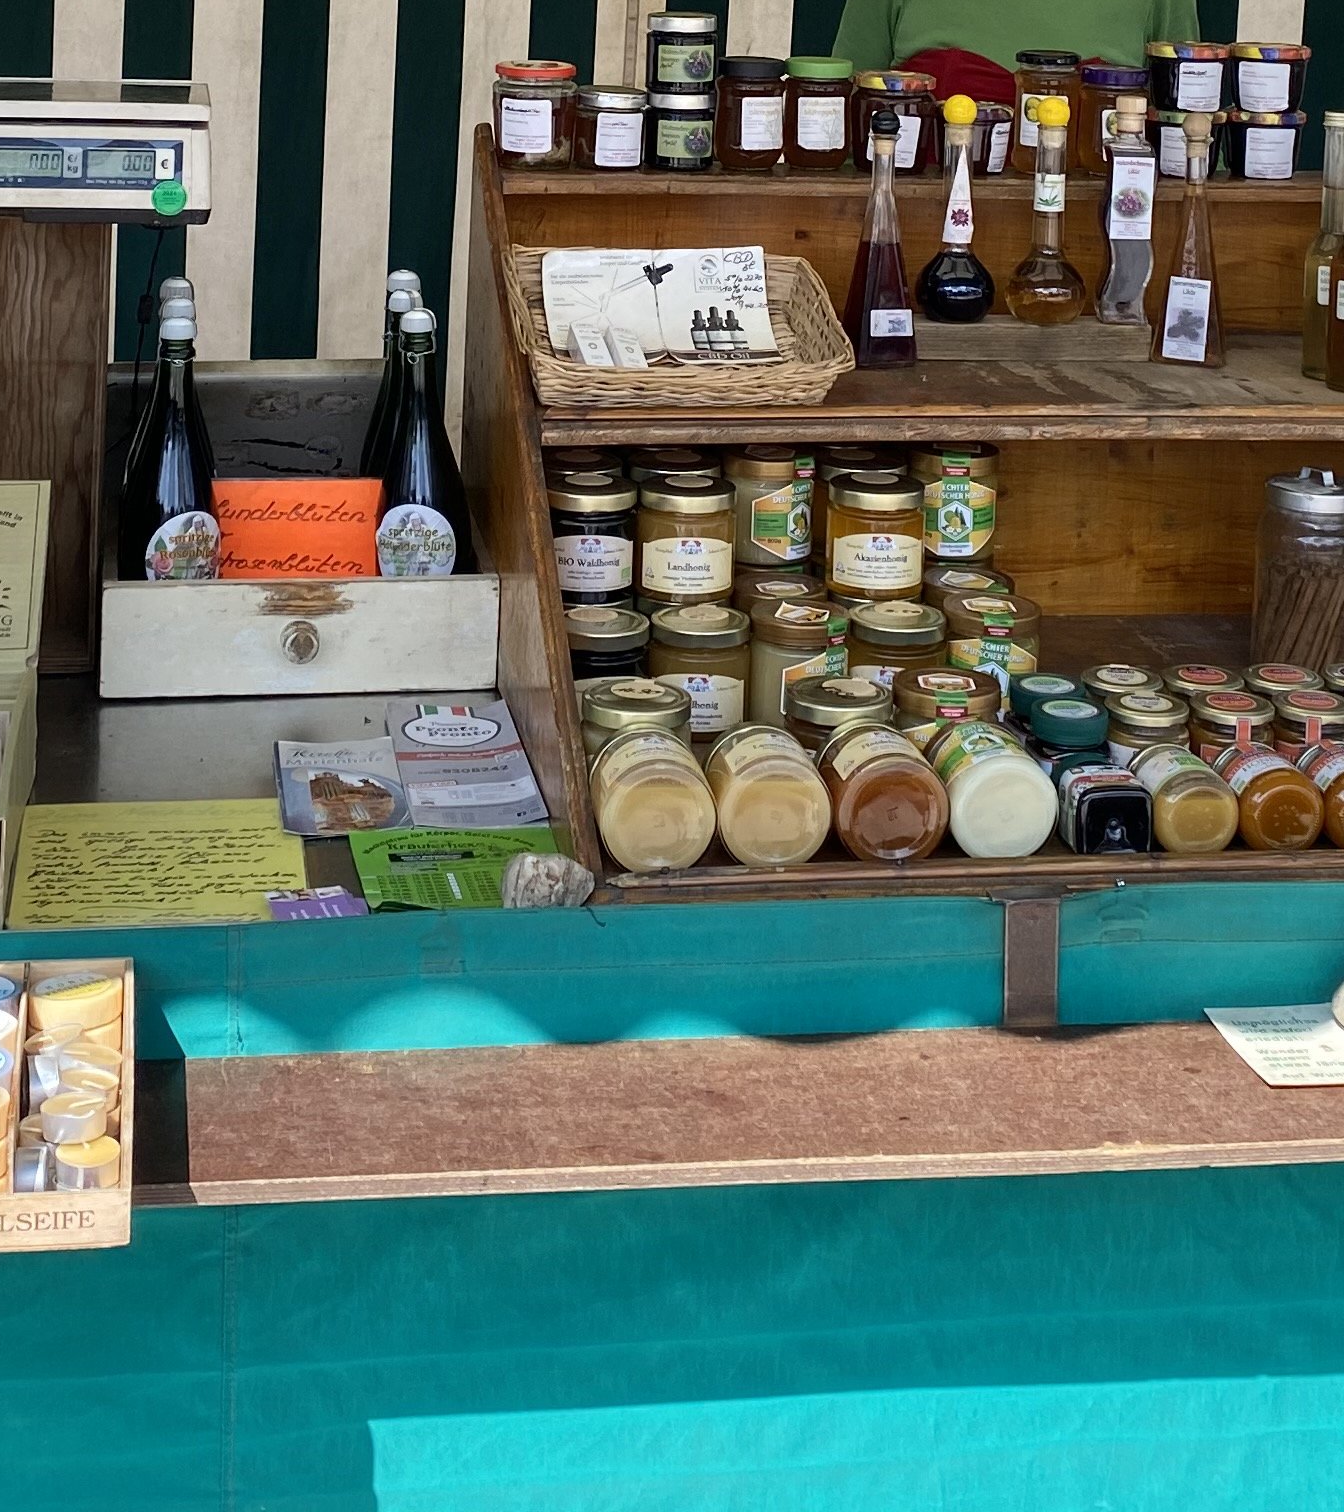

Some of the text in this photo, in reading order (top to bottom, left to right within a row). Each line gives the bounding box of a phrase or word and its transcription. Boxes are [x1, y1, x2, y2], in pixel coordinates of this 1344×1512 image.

[67, 163, 79, 174] kg
[161, 158, 169, 169] €
[698, 277, 722, 285] VITA
[13, 511, 24, 522] in
[388, 525, 439, 540] spritzige
[557, 555, 621, 567] BIO Waldhonig
[853, 552, 908, 564] Akazienhonig
[667, 561, 711, 572] Landhonig
